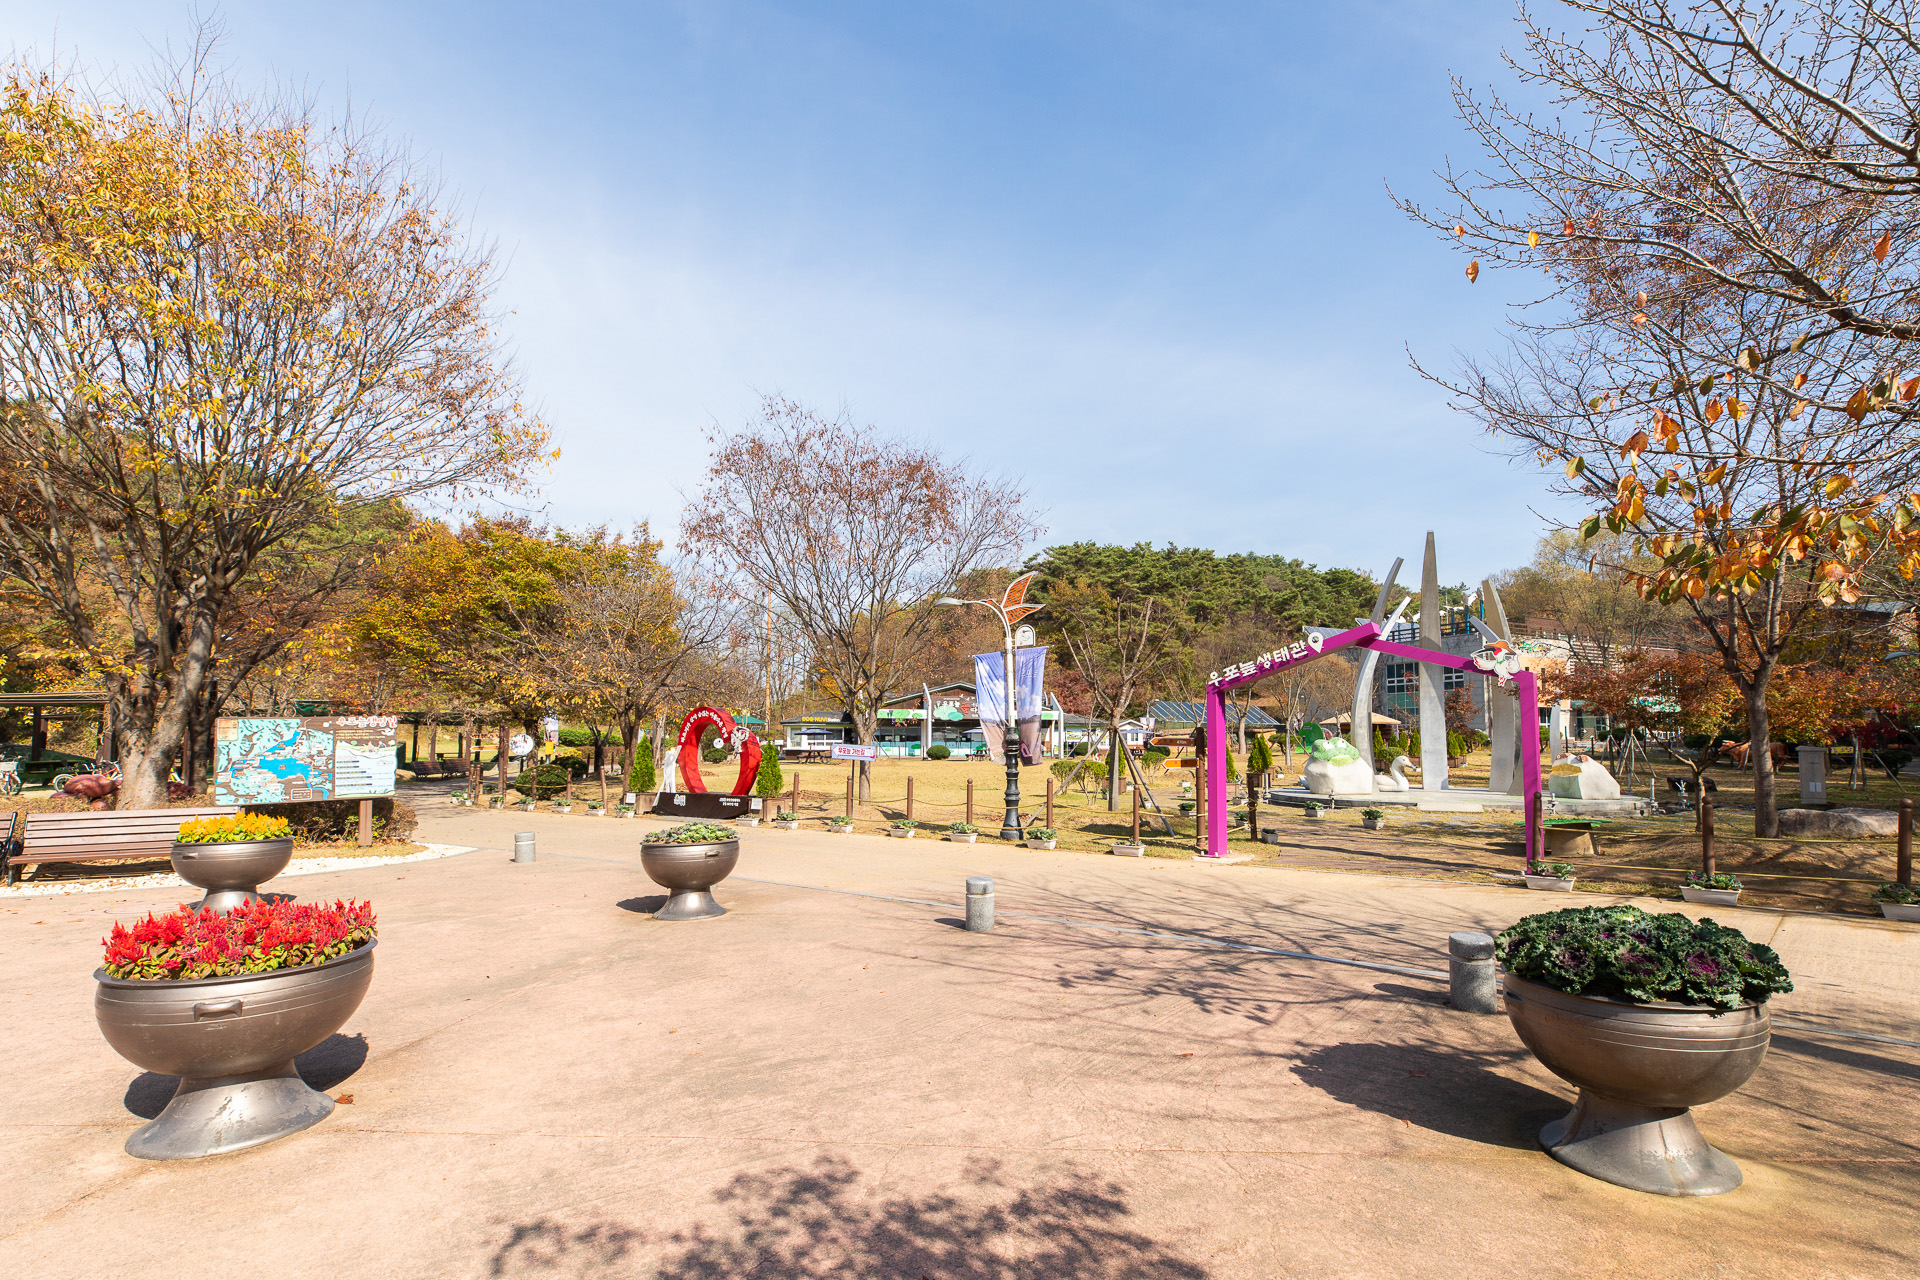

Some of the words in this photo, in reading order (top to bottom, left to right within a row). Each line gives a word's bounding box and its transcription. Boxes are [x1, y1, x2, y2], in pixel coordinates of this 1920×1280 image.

[1208, 639, 1309, 687] 우포늪생태관
[335, 715, 398, 729] 우포늪생명길
[838, 747, 851, 755] 우포늪
